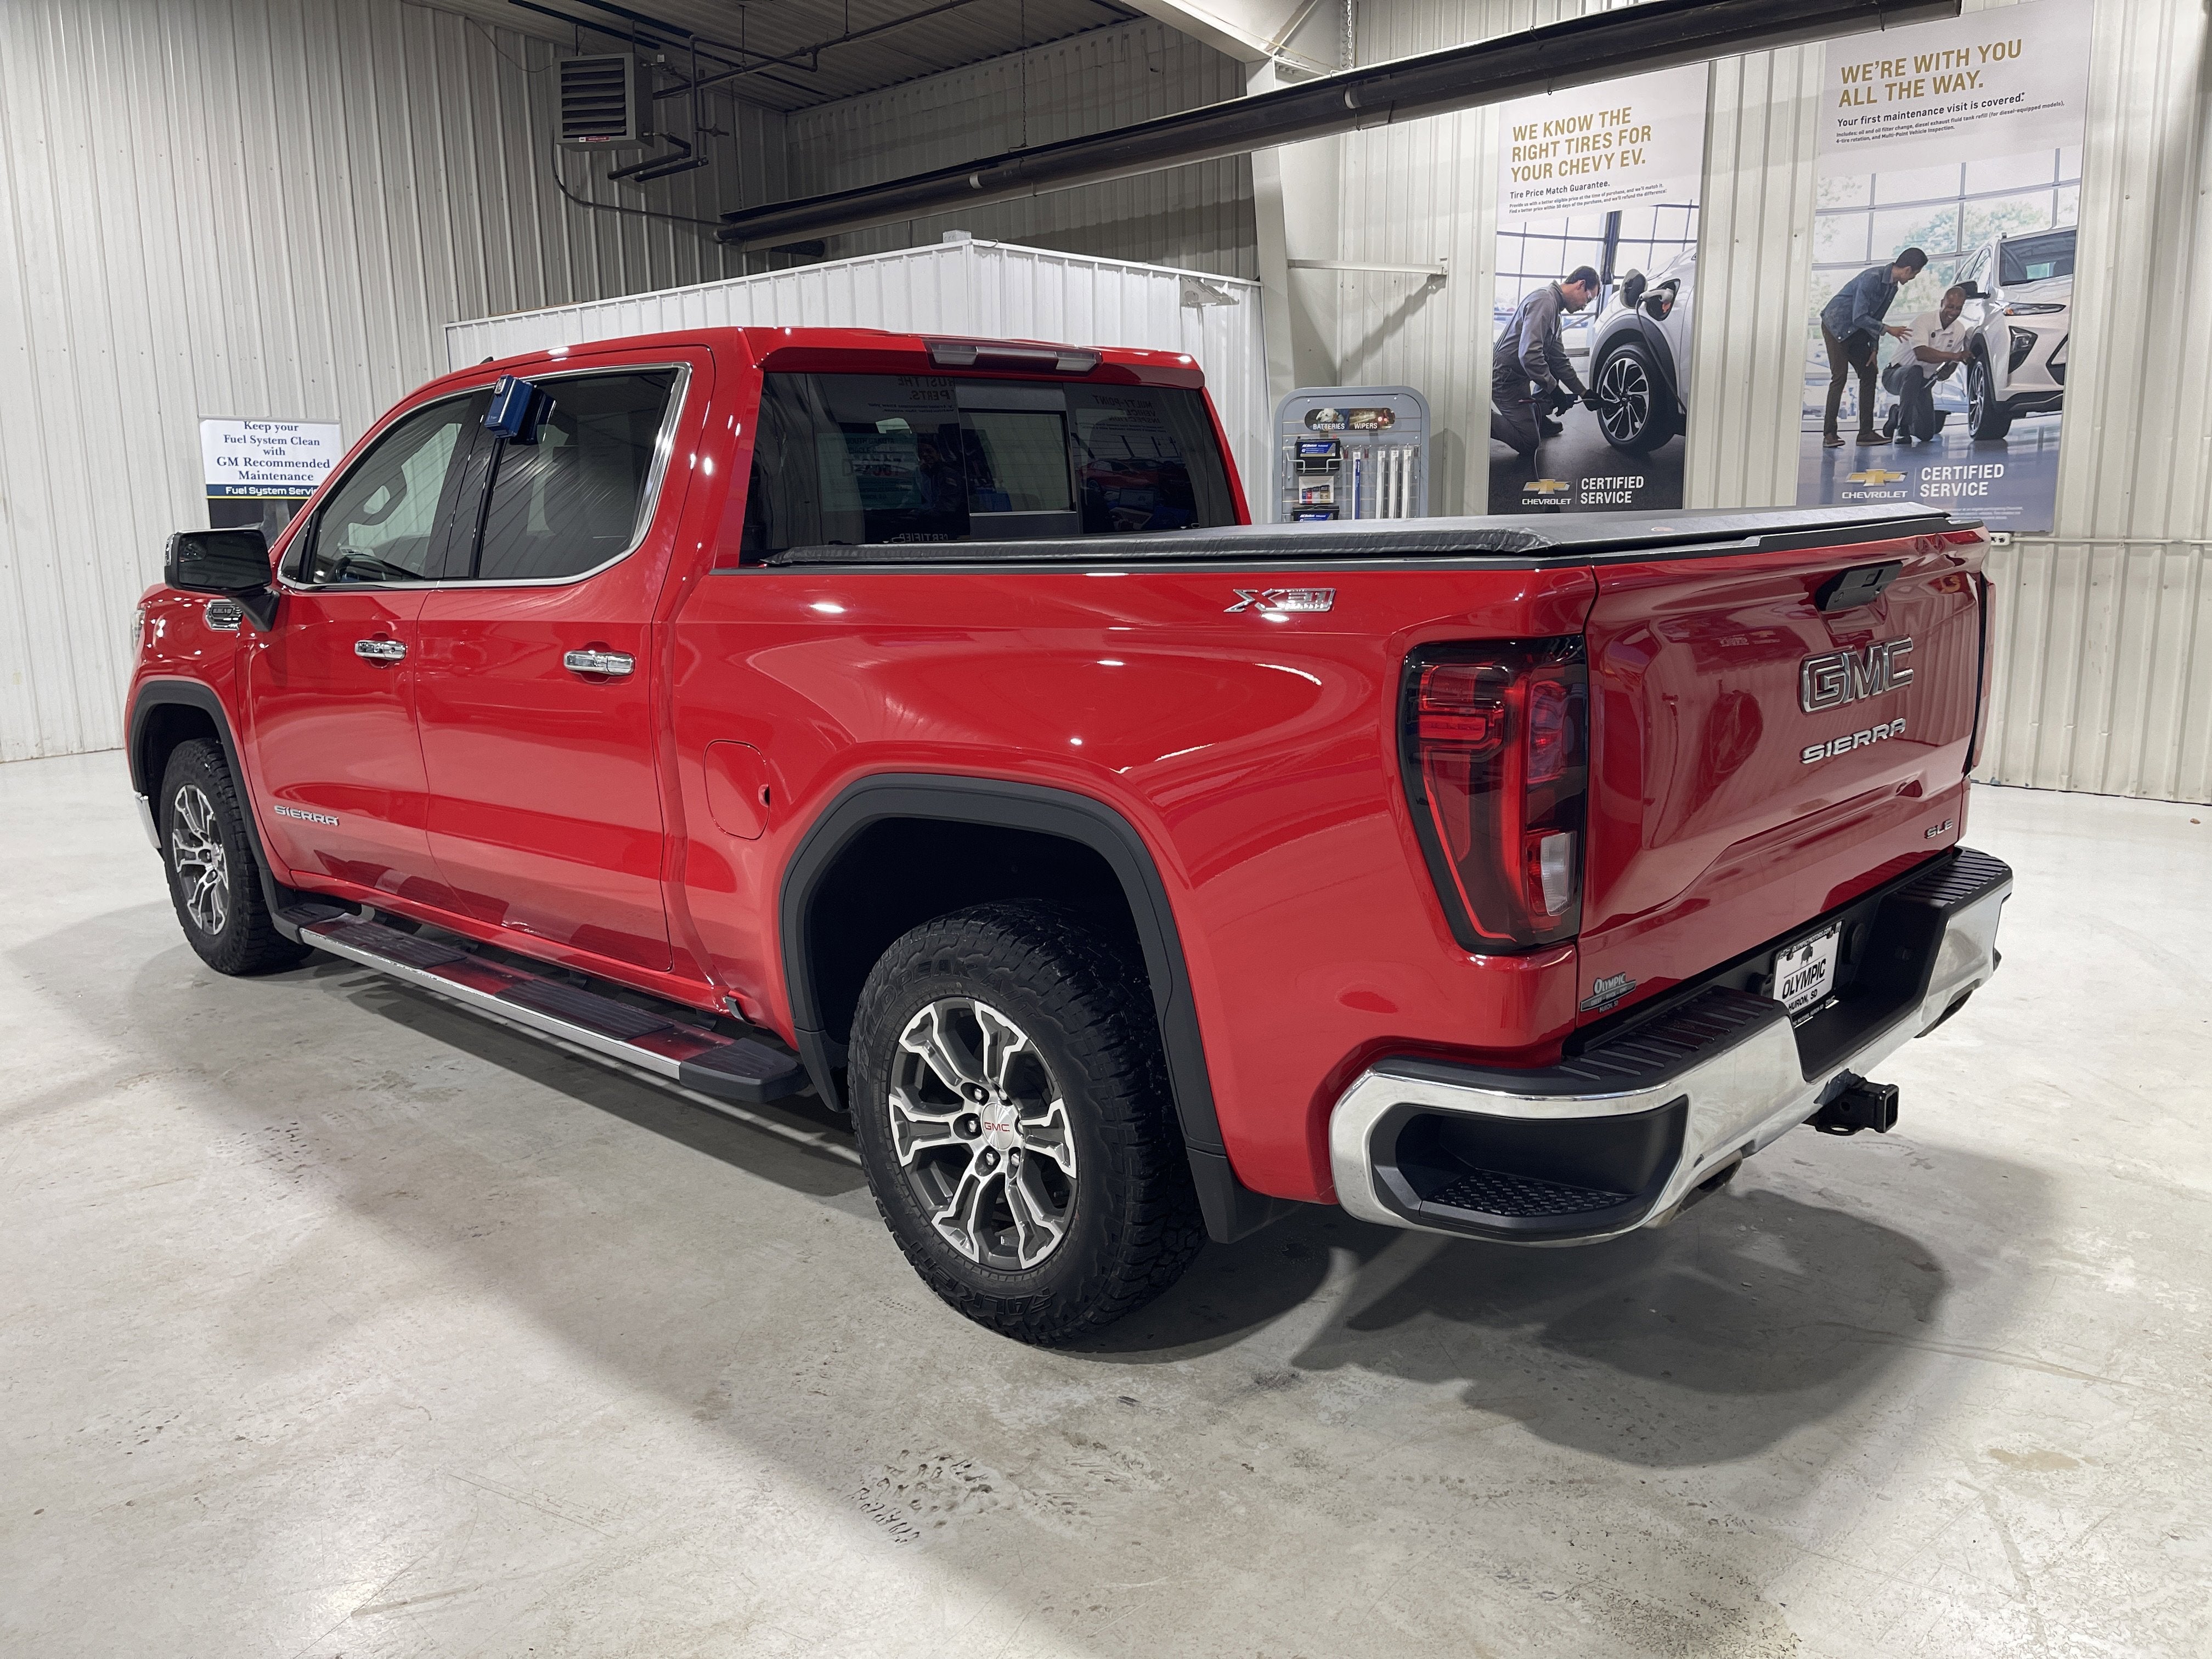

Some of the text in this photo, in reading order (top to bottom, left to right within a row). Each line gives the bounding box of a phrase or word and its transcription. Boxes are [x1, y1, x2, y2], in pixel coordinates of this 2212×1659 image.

[1841, 38, 2023, 84] WE'RE WITH YOU
[1838, 70, 1984, 108] ALL THE WAY.
[1838, 119, 1858, 127] Your
[1860, 115, 1881, 125] first
[1883, 107, 1944, 121] maintenance
[1947, 102, 1968, 112] visit
[1970, 101, 1978, 109] is
[1513, 107, 1632, 142] WE KNOW THE
[1511, 125, 1652, 162] RIGHT TIRES FOR
[1510, 148, 1646, 183] YOUR CHEVY EV.
[1525, 189, 1544, 197] Price
[1545, 185, 1568, 195] Match
[1570, 180, 1610, 191] Guarantee.
[243, 421, 299, 433] Keep your
[223, 435, 320, 447] Fuel System Clean
[263, 447, 285, 455] with
[217, 456, 330, 469] GM Recommended
[239, 471, 314, 481] Maintenance
[1921, 464, 2005, 482] CERTIFIED
[225, 486, 247, 495] Fuel
[249, 487, 287, 496] System
[1581, 476, 1644, 490] CERTIFIED
[1842, 482, 1989, 499] CHEVROLET SERVICE
[1581, 490, 1632, 505] SERVICE
[1801, 636, 1914, 713] GMC
[1801, 718, 1906, 764] SIERRA
[274, 805, 339, 826] SIERRA
[1926, 819, 1953, 839] SLE
[1594, 973, 1626, 994] OLYMPIC
[1782, 958, 1826, 1000] OLYMPIC
[1810, 989, 1818, 1000] SD
[984, 1122, 1010, 1132] GMC
